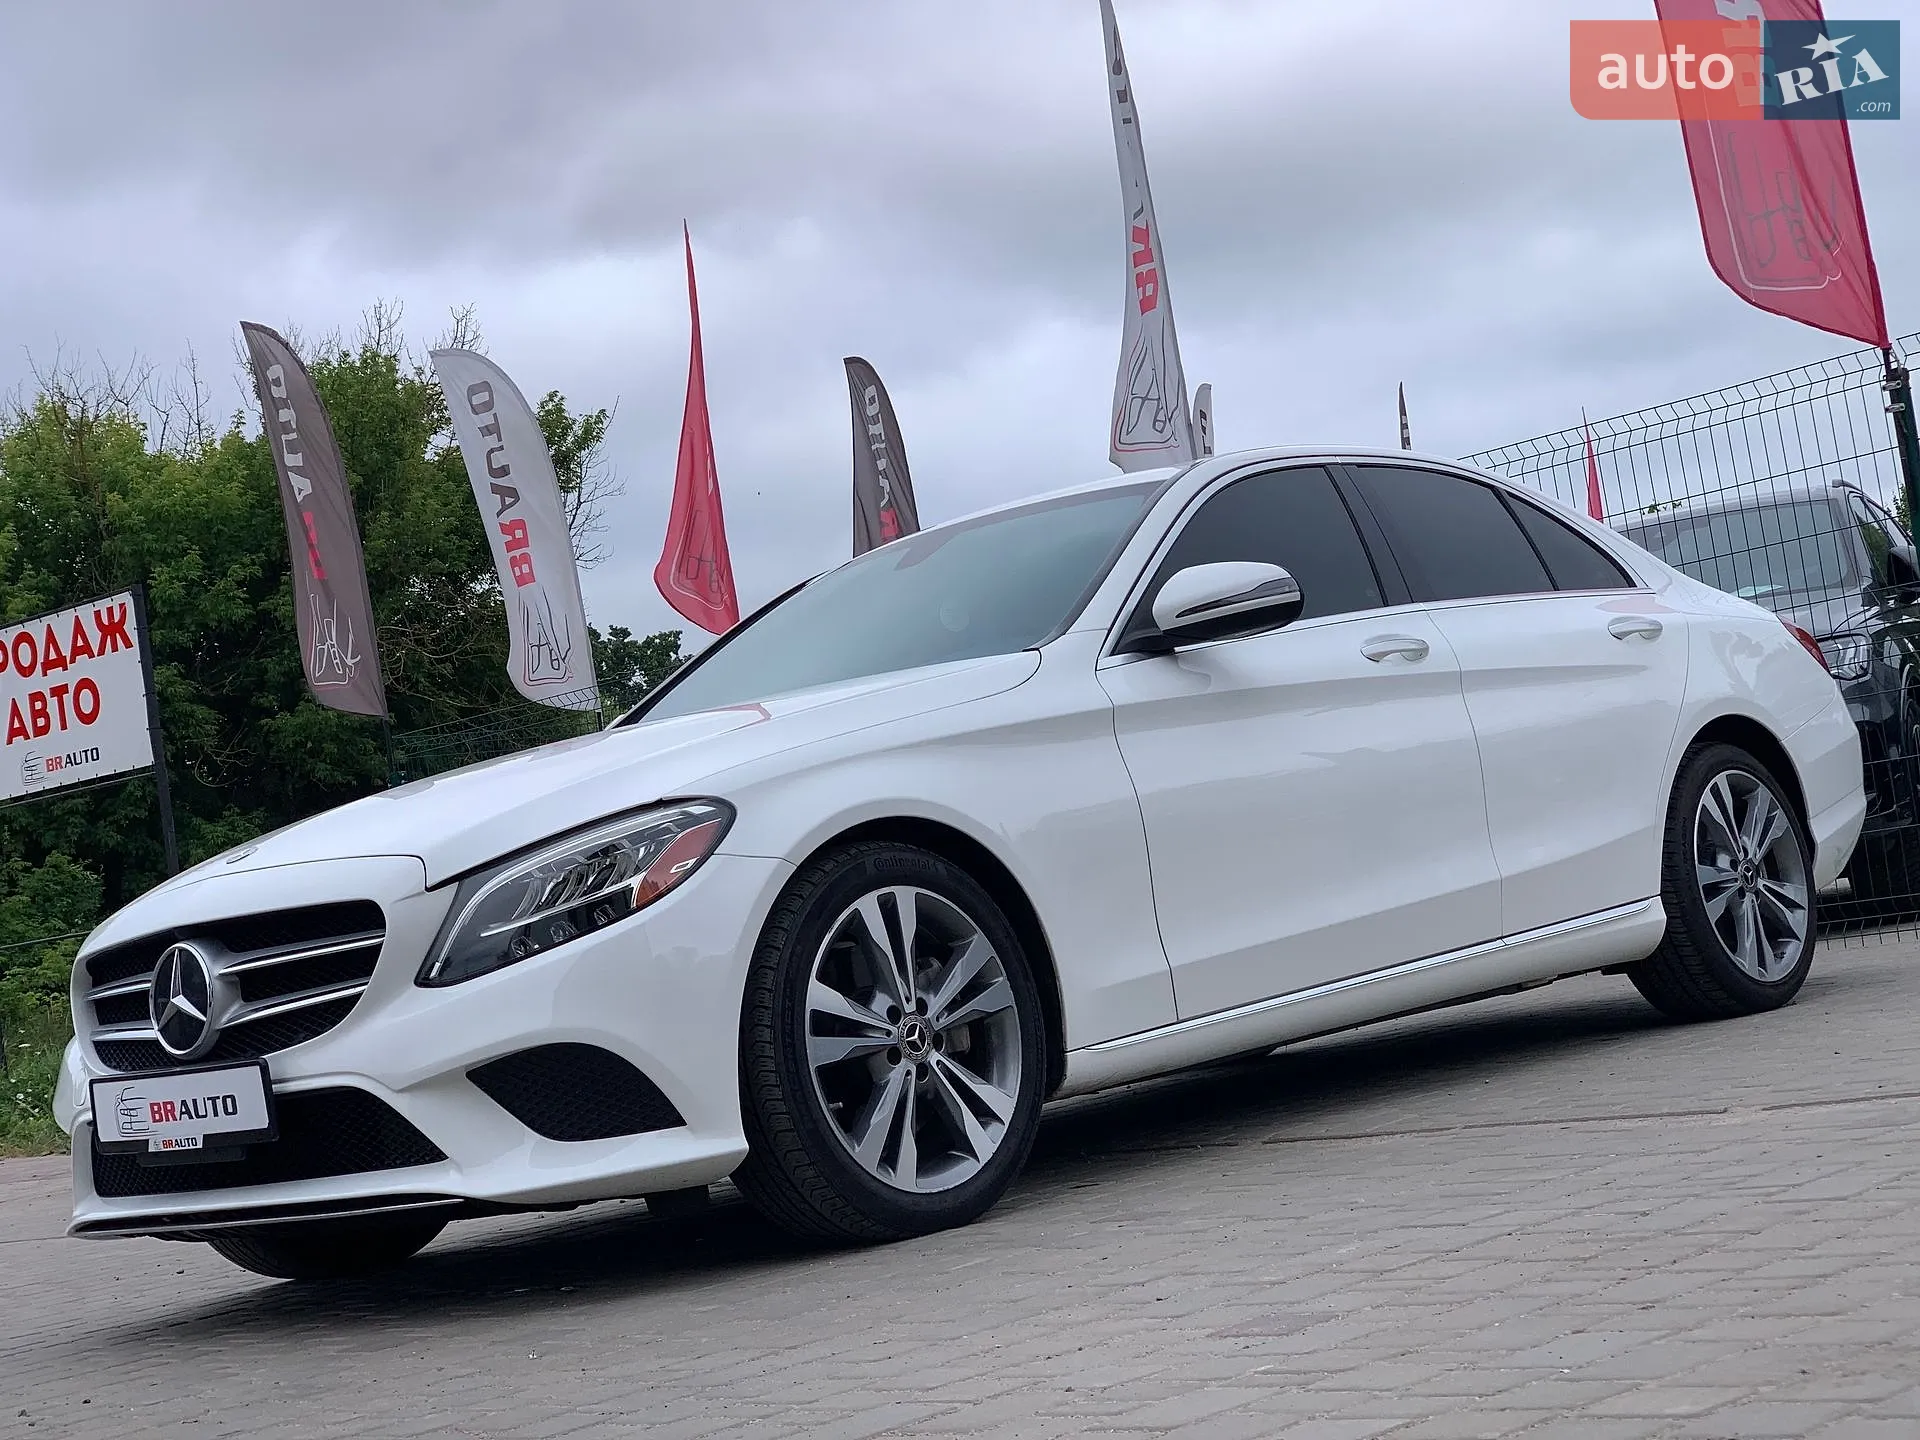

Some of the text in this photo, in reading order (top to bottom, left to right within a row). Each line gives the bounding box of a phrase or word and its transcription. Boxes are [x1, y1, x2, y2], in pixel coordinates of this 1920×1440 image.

[6, 677, 101, 745] АВТО
[45, 747, 100, 772] BRAUTO
[149, 1094, 238, 1123] BRAUTO
[162, 1137, 197, 1149] BRAUTO
